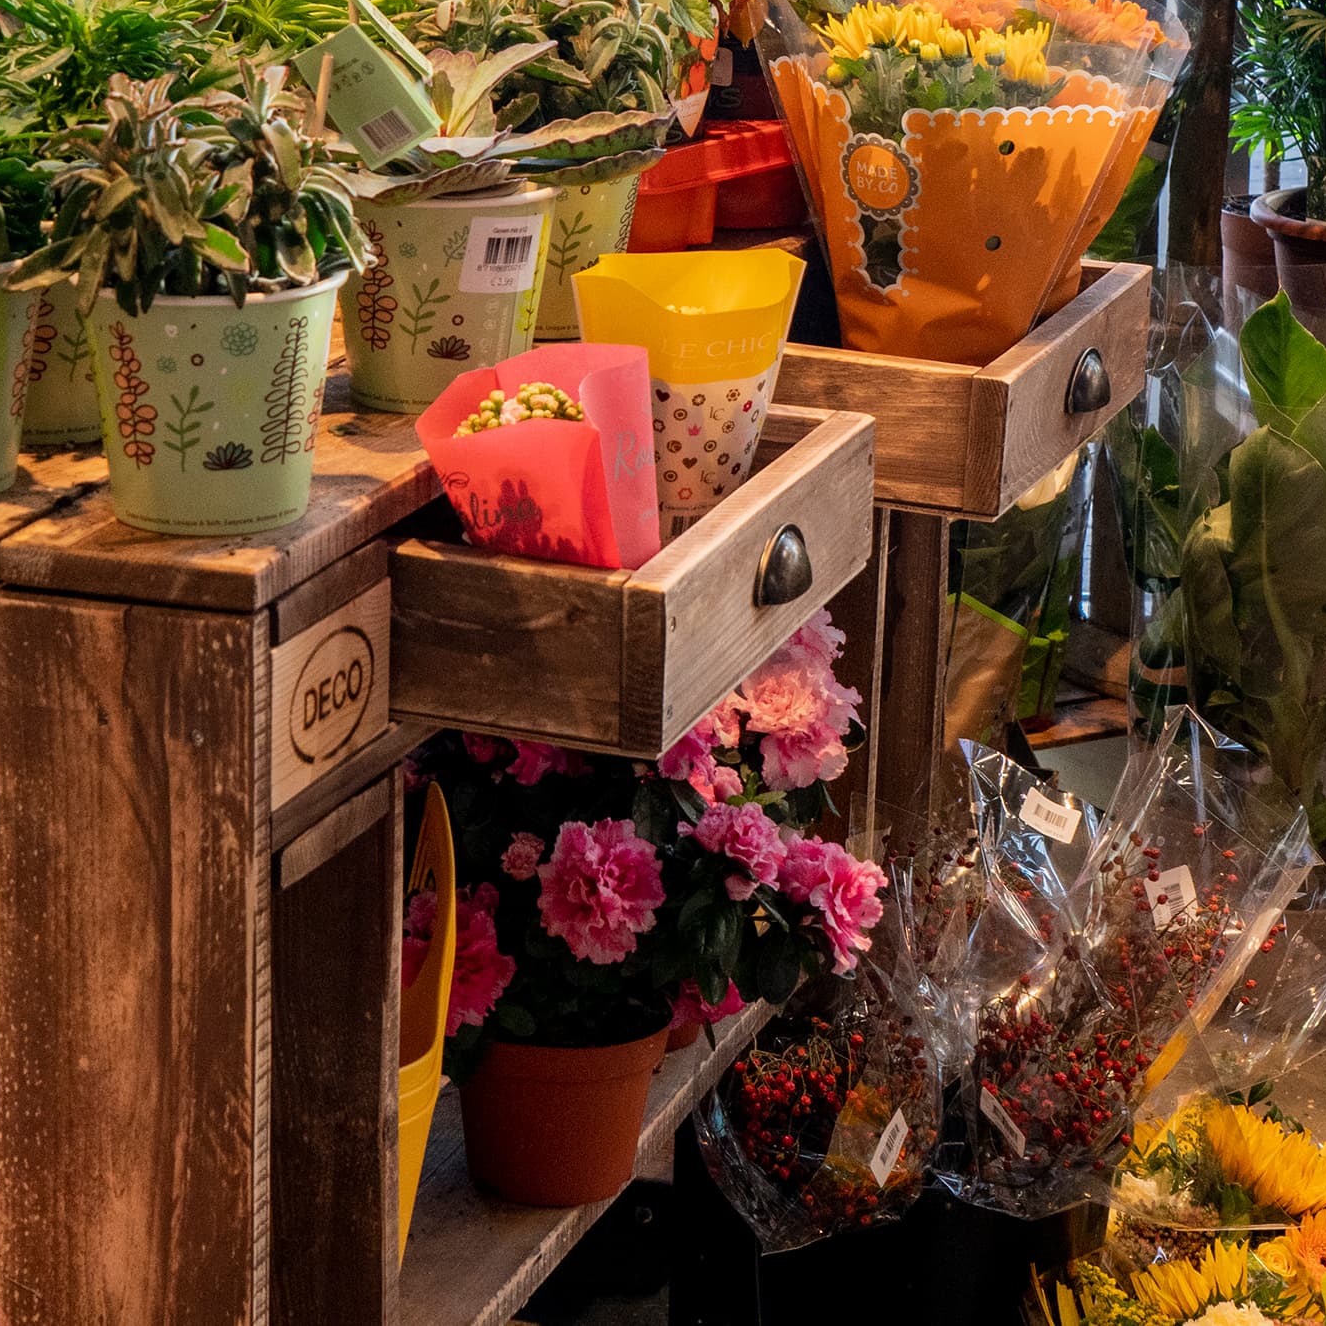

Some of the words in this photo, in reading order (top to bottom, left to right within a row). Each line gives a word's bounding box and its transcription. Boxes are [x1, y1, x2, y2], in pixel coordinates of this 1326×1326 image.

[857, 160, 898, 180] MADE
[706, 330, 772, 358] CHIC
[303, 659, 362, 730] DECO
